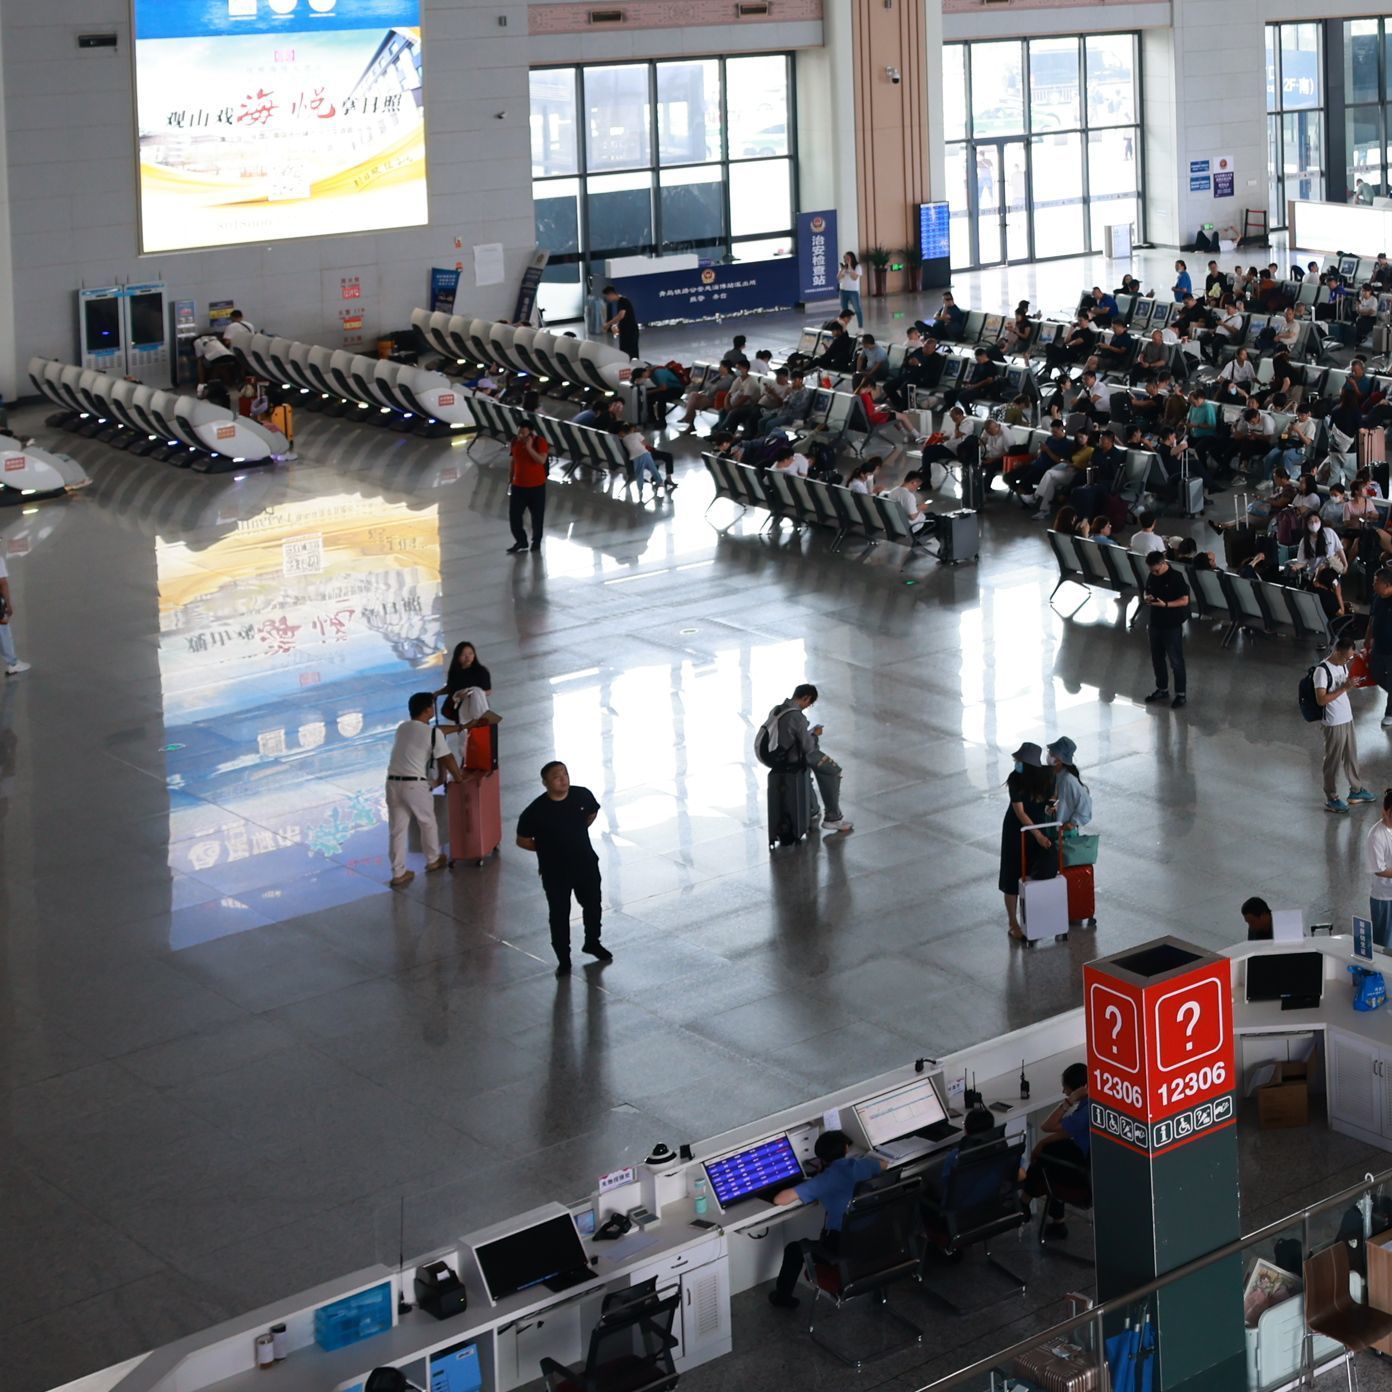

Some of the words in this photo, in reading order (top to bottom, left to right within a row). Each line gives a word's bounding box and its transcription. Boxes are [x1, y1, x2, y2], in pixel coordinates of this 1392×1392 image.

[811, 235, 826, 286] 治安检查站
[1093, 1069, 1143, 1108] 12306
[1158, 1061, 1226, 1106] 12306
